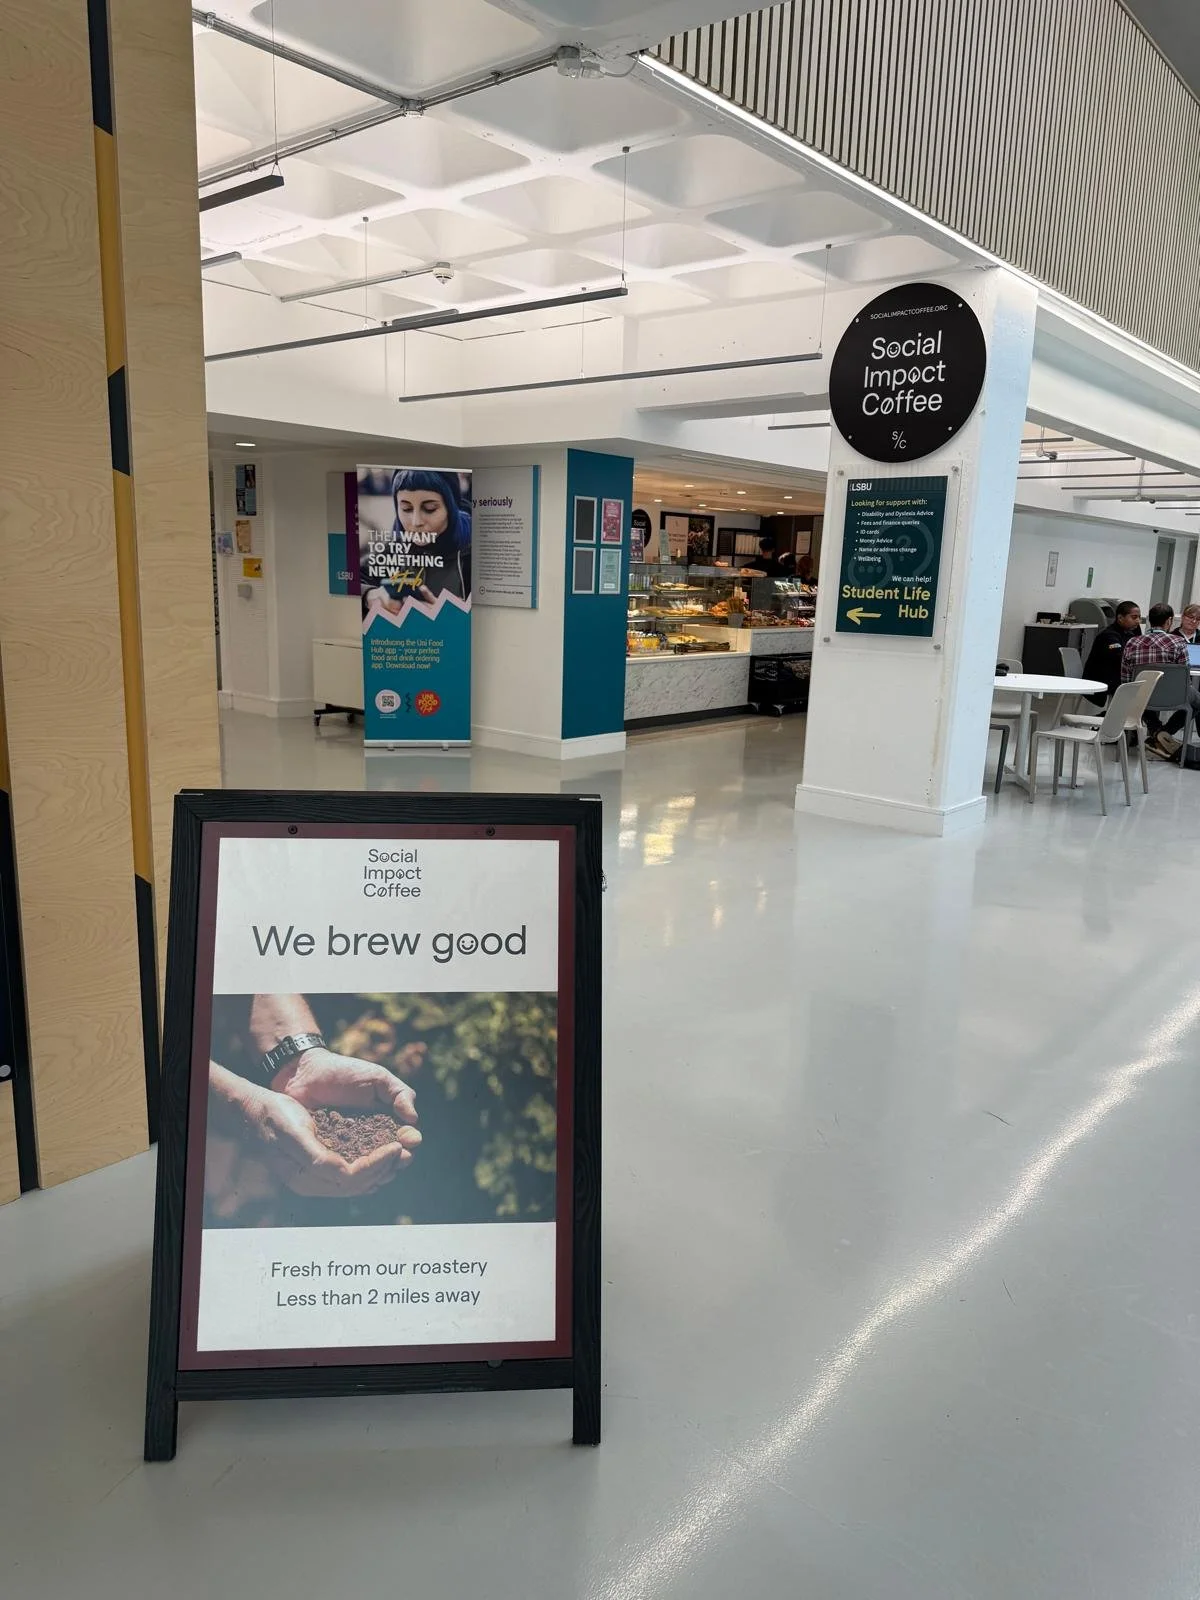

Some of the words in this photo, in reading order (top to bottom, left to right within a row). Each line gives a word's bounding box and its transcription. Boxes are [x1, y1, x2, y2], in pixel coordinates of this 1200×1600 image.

[870, 304, 948, 320] SOCIALIMPACTCOFFEE.ORG
[871, 330, 942, 360] Social
[863, 360, 946, 391] Impact
[862, 389, 942, 416] Coffee
[851, 482, 872, 492] LSBU
[478, 497, 513, 507] seriously
[886, 499, 911, 507] support
[367, 529, 391, 542] THE
[399, 530, 438, 543] WANT
[367, 541, 386, 553] TO
[388, 542, 412, 554] TRY
[368, 553, 444, 568] SOMETHING
[368, 565, 400, 577] NEW
[842, 585, 899, 599] Student
[903, 586, 931, 600] Life
[898, 604, 929, 619] Hub
[370, 639, 405, 647] Introducing
[368, 848, 418, 863] Social
[363, 865, 422, 883] Impact
[363, 882, 421, 898] Coffee
[252, 925, 315, 956] We
[327, 925, 421, 956] brew
[432, 925, 527, 964] good
[270, 1261, 322, 1279] Fresh
[327, 1260, 371, 1276] from
[376, 1262, 407, 1275] our
[412, 1259, 488, 1277] roastery
[276, 1289, 316, 1307] Less
[322, 1288, 362, 1305] than
[367, 1289, 378, 1305] 2
[384, 1286, 430, 1304] miles
[435, 1288, 481, 1305] away
